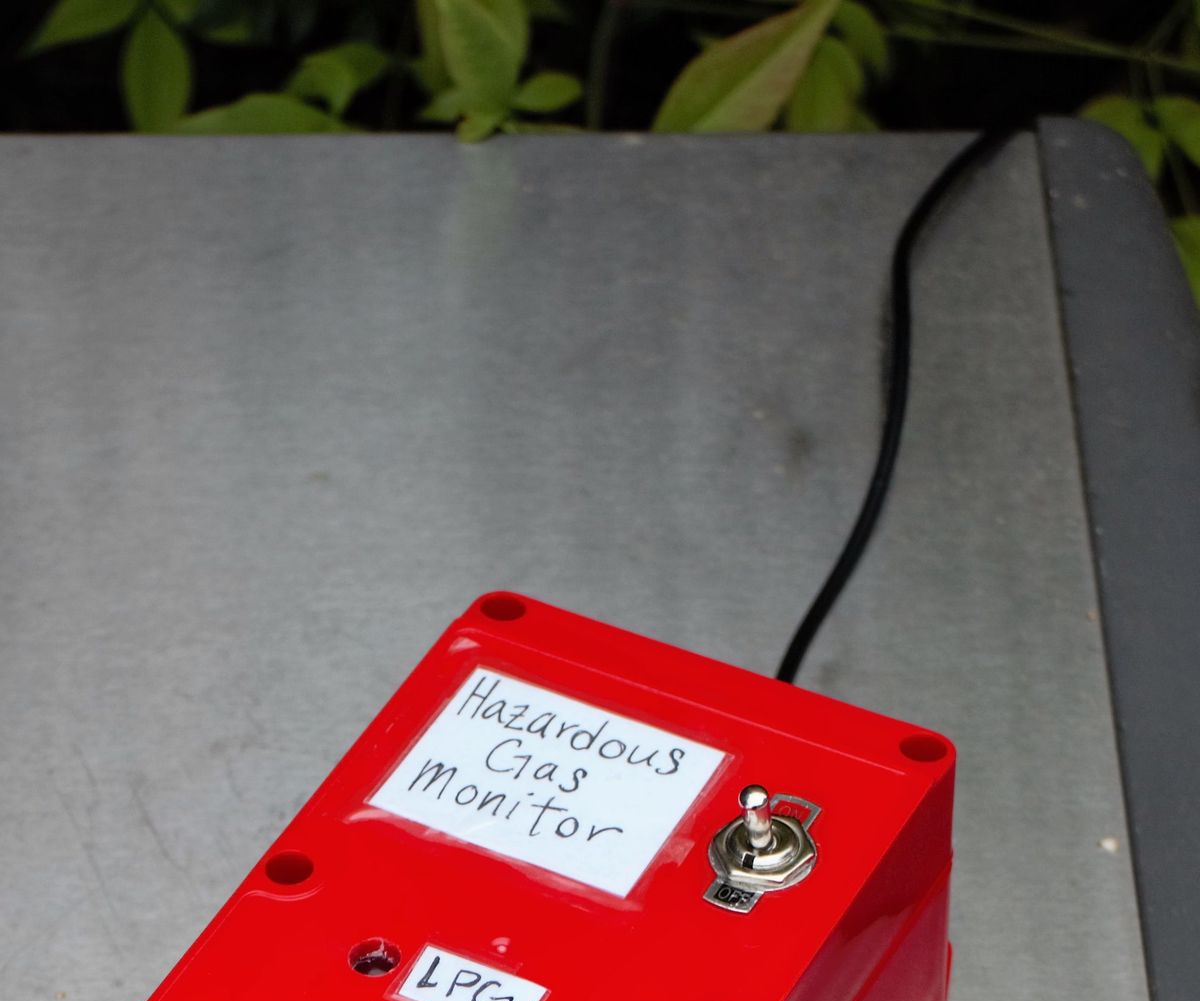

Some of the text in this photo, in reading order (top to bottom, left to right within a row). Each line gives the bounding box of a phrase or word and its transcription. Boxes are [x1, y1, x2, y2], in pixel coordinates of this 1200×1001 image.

[456, 675, 686, 776] Hazardous
[484, 738, 588, 793] Gas
[717, 886, 752, 906] OFF
